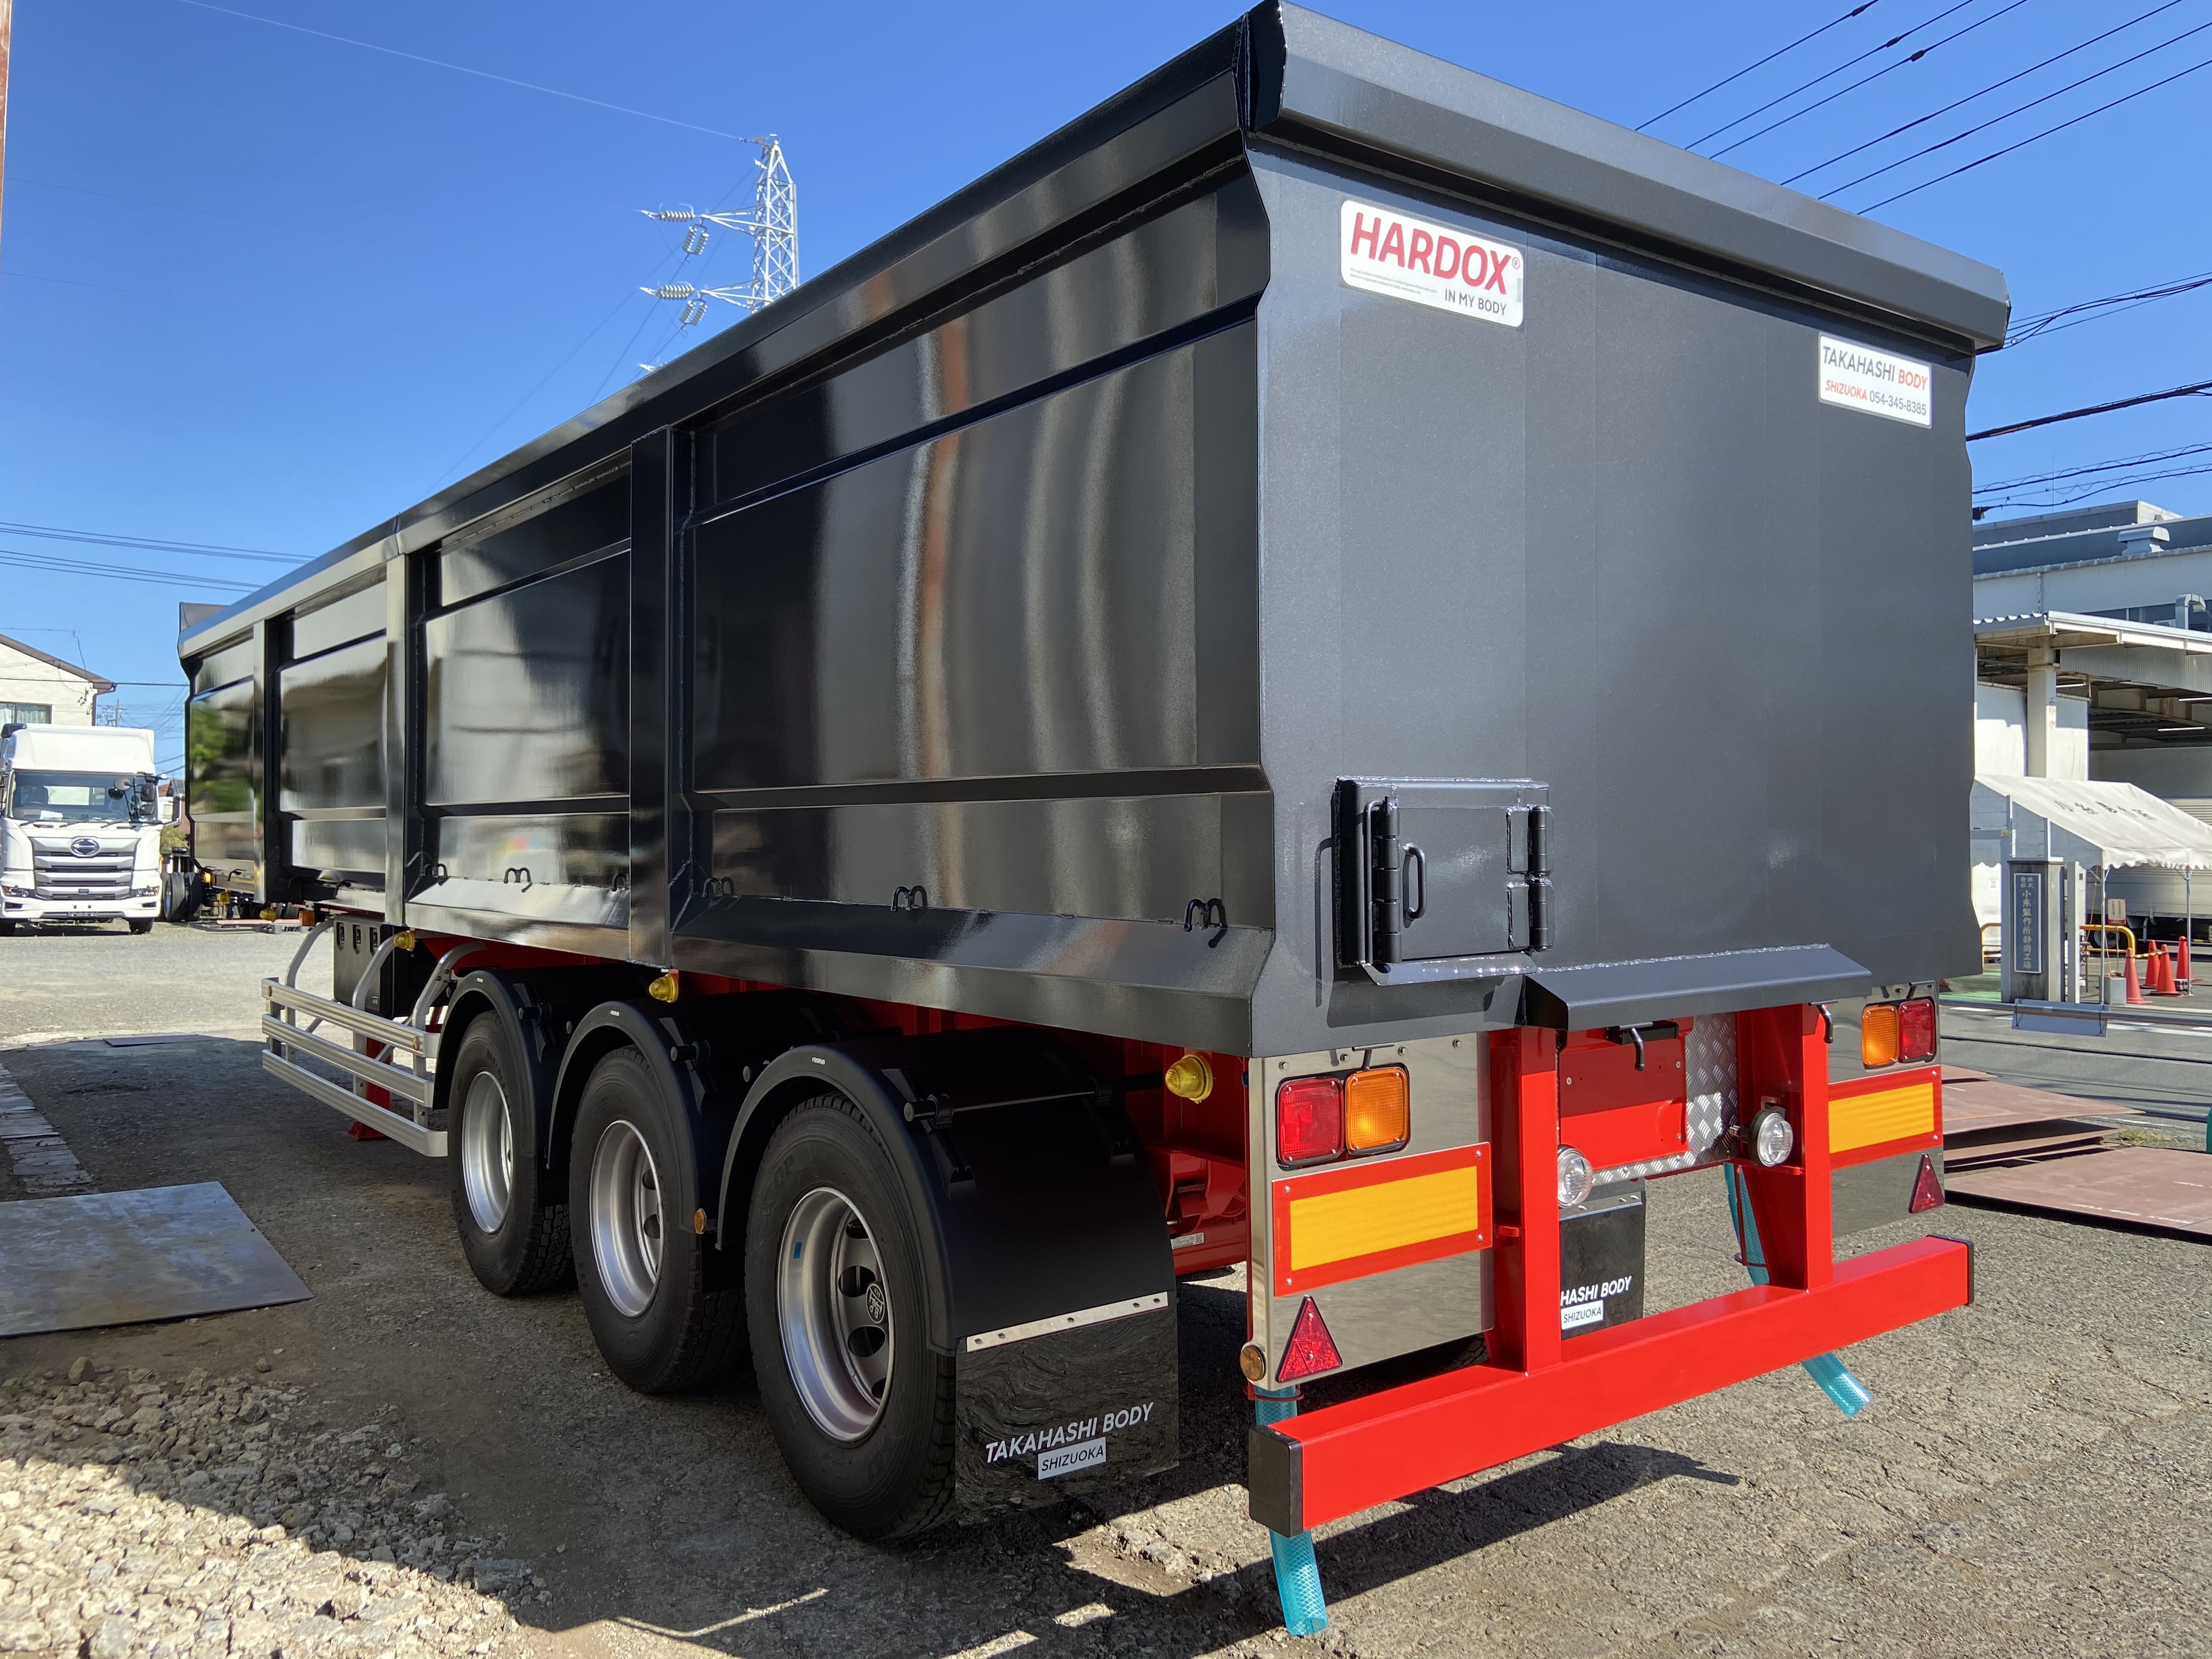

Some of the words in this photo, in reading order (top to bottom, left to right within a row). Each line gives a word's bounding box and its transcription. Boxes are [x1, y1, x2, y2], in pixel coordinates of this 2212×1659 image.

[1444, 288, 1455, 303] IN
[1459, 292, 1475, 308] MY
[1478, 298, 1506, 316] BODY
[1823, 346, 1895, 382] TAKAHASHI
[1898, 369, 1928, 391] BODY
[1825, 380, 1867, 400] SHIZUOKA
[1870, 390, 1926, 416] 054-345-8385
[1600, 1276, 1632, 1297] BODY
[1563, 1306, 1601, 1323] SHIZUOKA
[986, 1417, 1098, 1463] TAKAHASHI
[1102, 1402, 1154, 1432] BODY
[1041, 1444, 1104, 1471] SHIZUOKA
